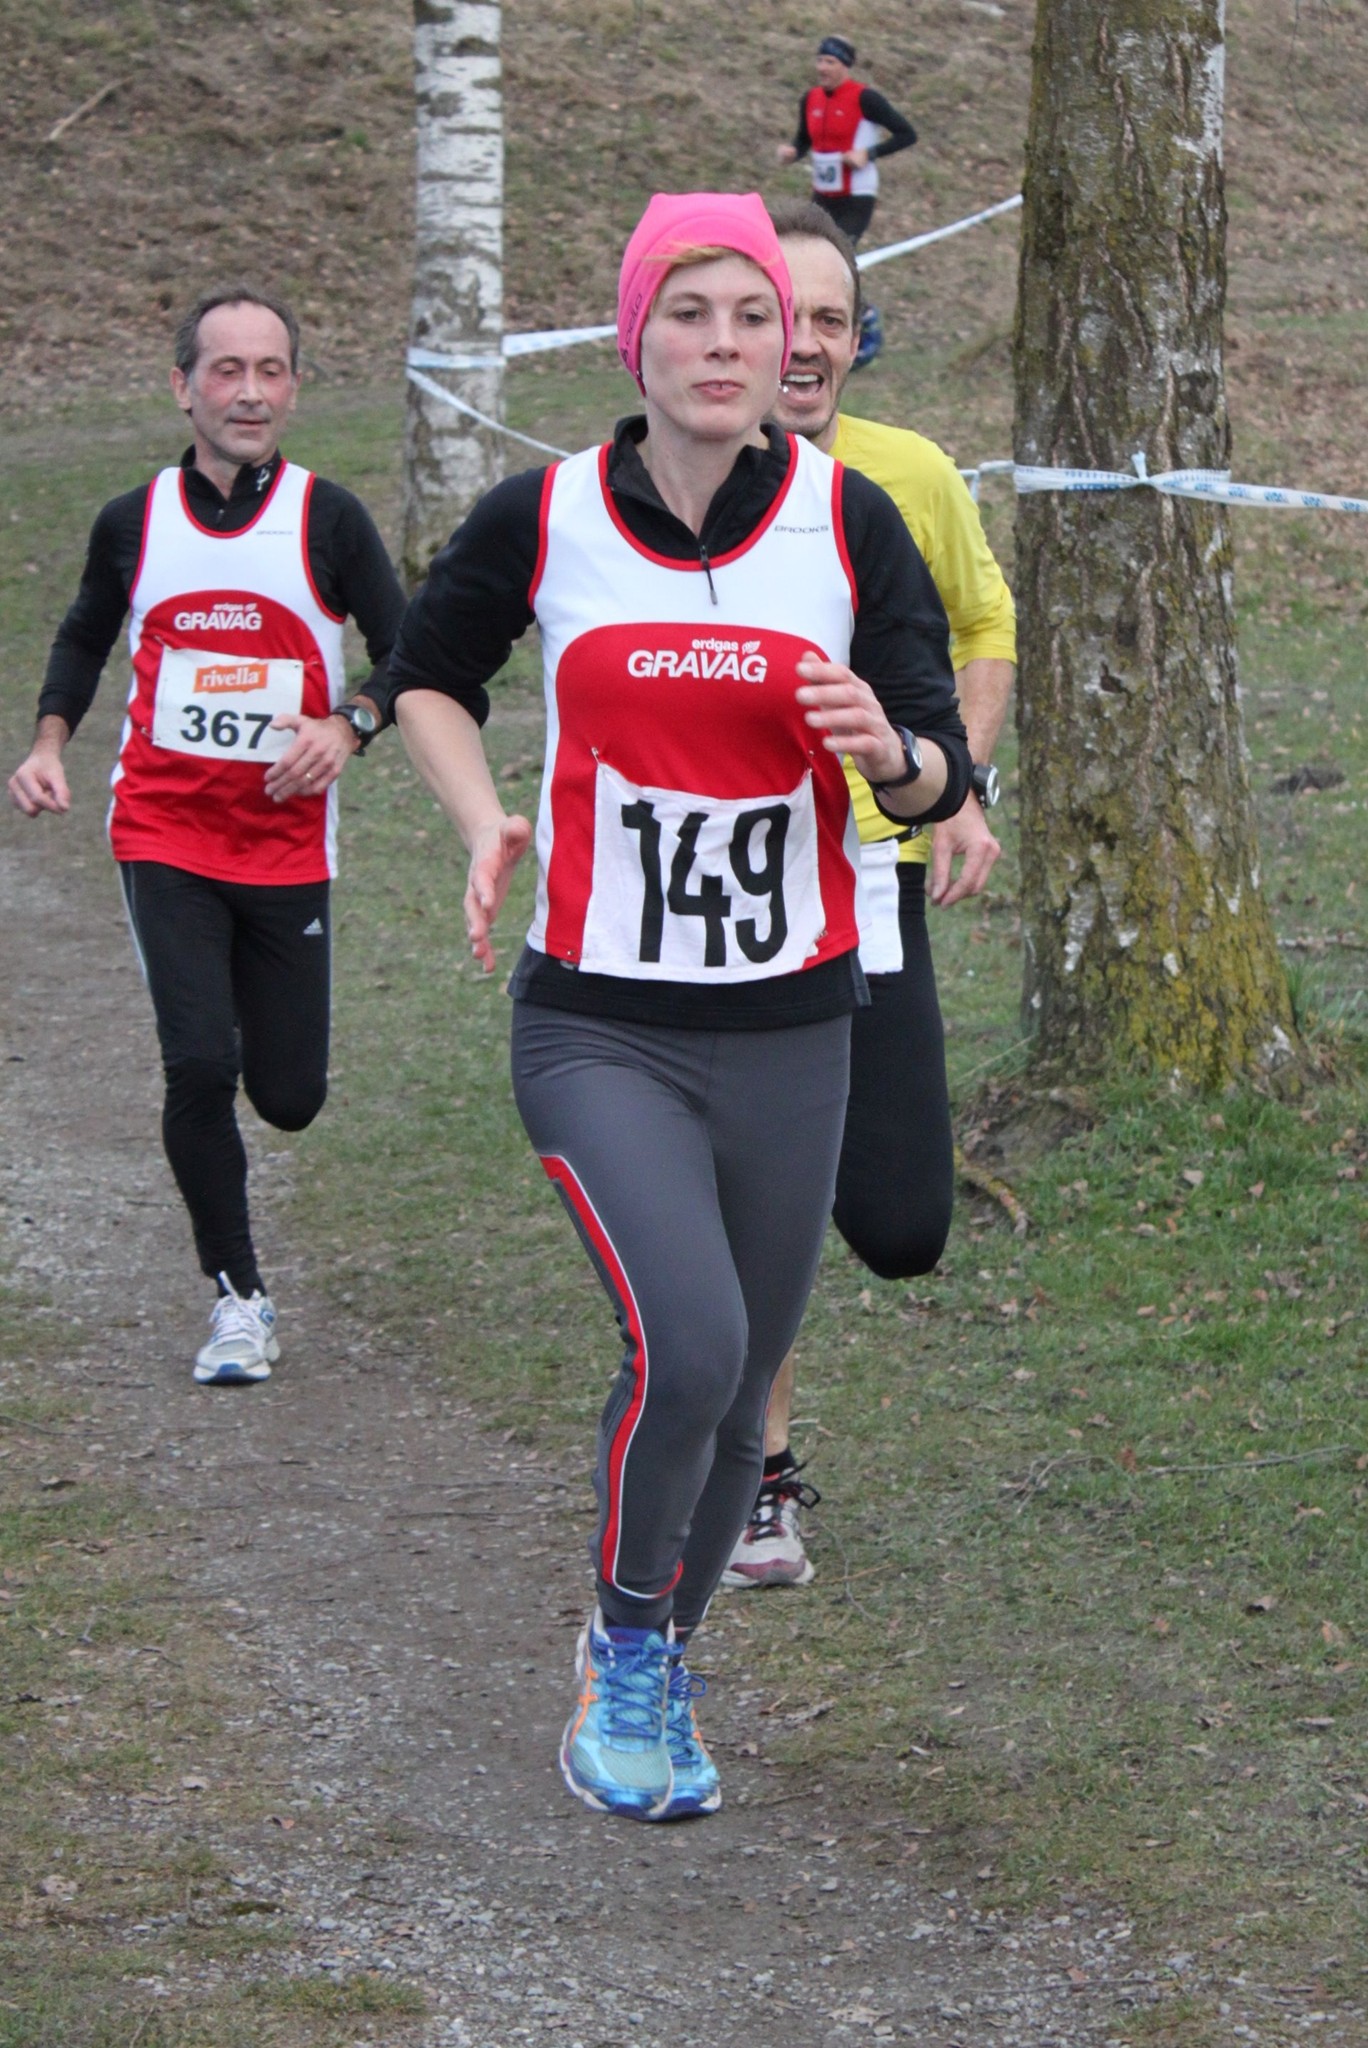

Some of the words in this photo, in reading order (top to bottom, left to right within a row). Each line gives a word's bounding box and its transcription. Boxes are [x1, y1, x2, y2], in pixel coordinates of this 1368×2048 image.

[625, 293, 642, 345] odlo
[774, 524, 829, 534] BROOKS
[174, 612, 262, 630] GRAVAG
[692, 638, 739, 653] erdgas
[201, 668, 259, 687] rivella
[628, 650, 767, 683] GRAVAG
[180, 704, 273, 749] 367
[621, 800, 791, 967] 149
